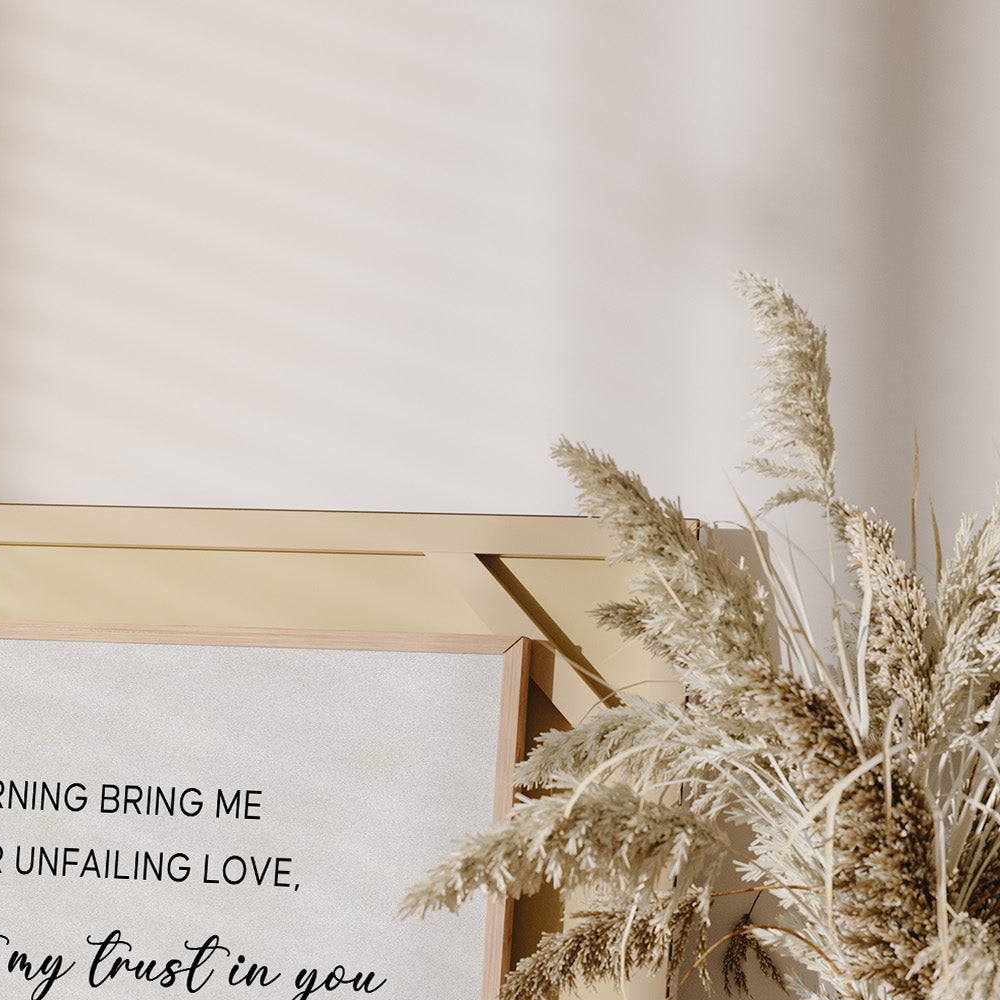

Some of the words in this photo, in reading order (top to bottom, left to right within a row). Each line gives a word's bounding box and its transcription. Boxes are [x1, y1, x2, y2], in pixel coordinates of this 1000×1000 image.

[101, 784, 203, 816] BRING
[216, 789, 261, 819] ME
[16, 846, 190, 882] UNFAILING
[204, 855, 299, 891] LOVE,
[87, 930, 230, 993] trust
[229, 955, 281, 986] in
